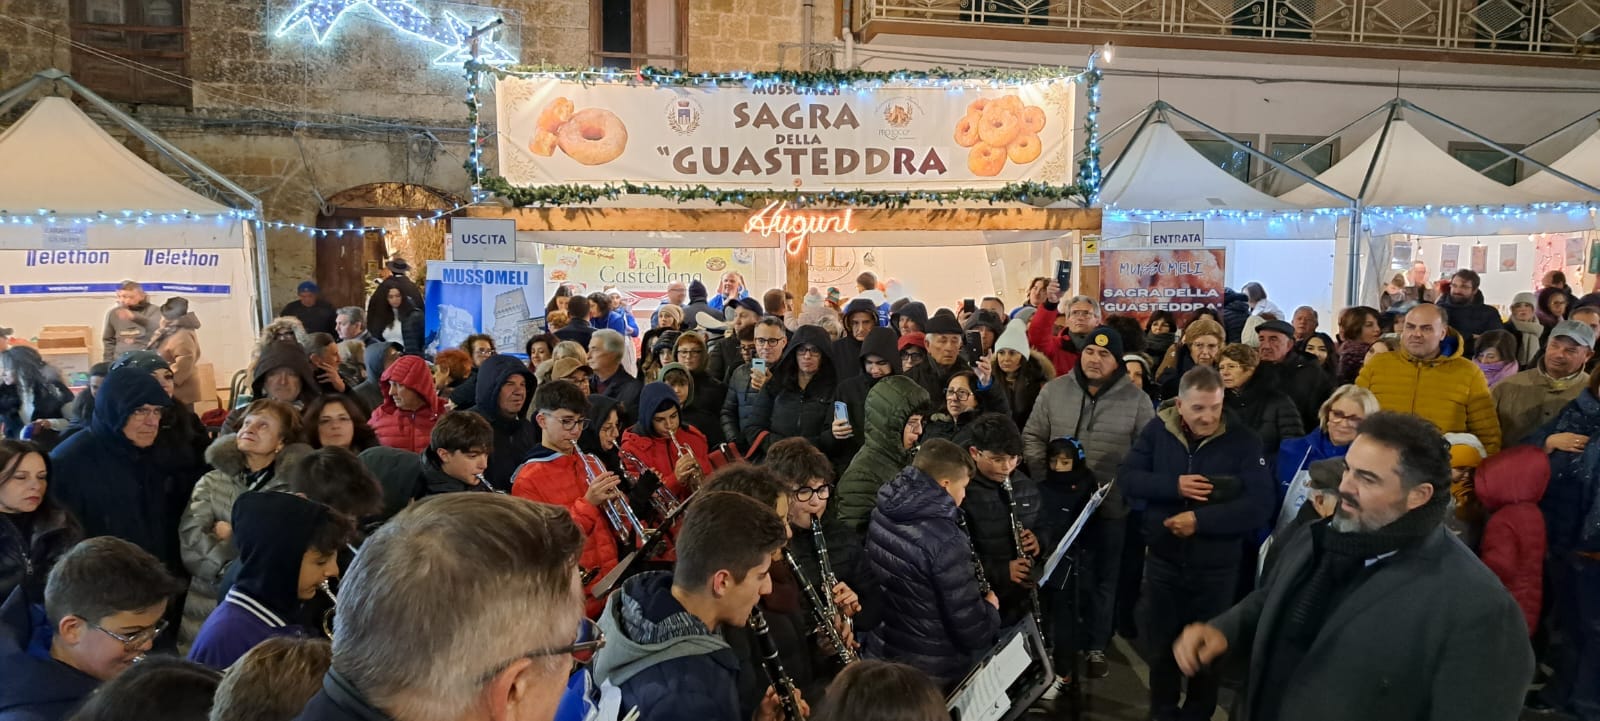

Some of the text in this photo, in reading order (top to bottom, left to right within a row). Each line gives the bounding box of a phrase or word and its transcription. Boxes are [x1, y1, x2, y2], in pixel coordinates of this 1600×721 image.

[733, 101, 860, 130] SAGRA
[775, 134, 822, 145] DELLA
[462, 234, 507, 245] USCITA
[1153, 233, 1201, 244] ENTRATA
[639, 259, 655, 270] La
[1119, 262, 1204, 277] MUSSOMELI
[442, 268, 529, 286] MUSSOMELI
[1103, 288, 1219, 298] SAGRA DELLA
